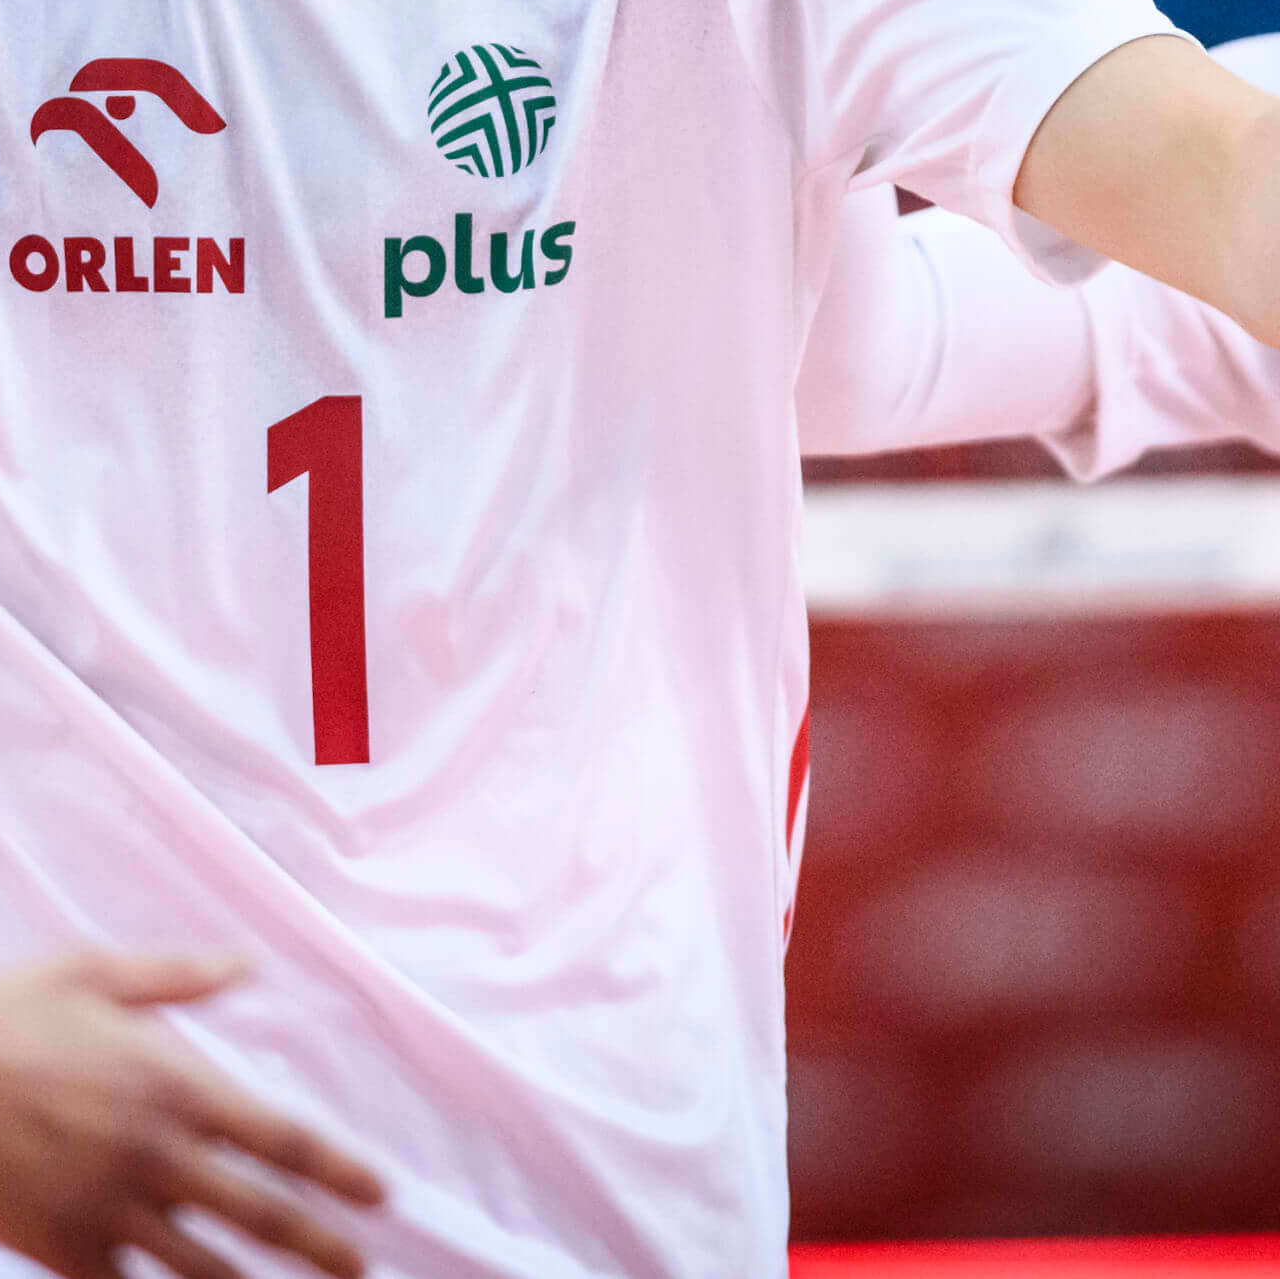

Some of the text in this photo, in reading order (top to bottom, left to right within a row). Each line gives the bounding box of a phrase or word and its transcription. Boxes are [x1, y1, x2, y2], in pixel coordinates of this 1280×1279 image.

[9, 234, 245, 294] ORLEN
[384, 213, 576, 319] plus
[266, 395, 371, 767] 1
